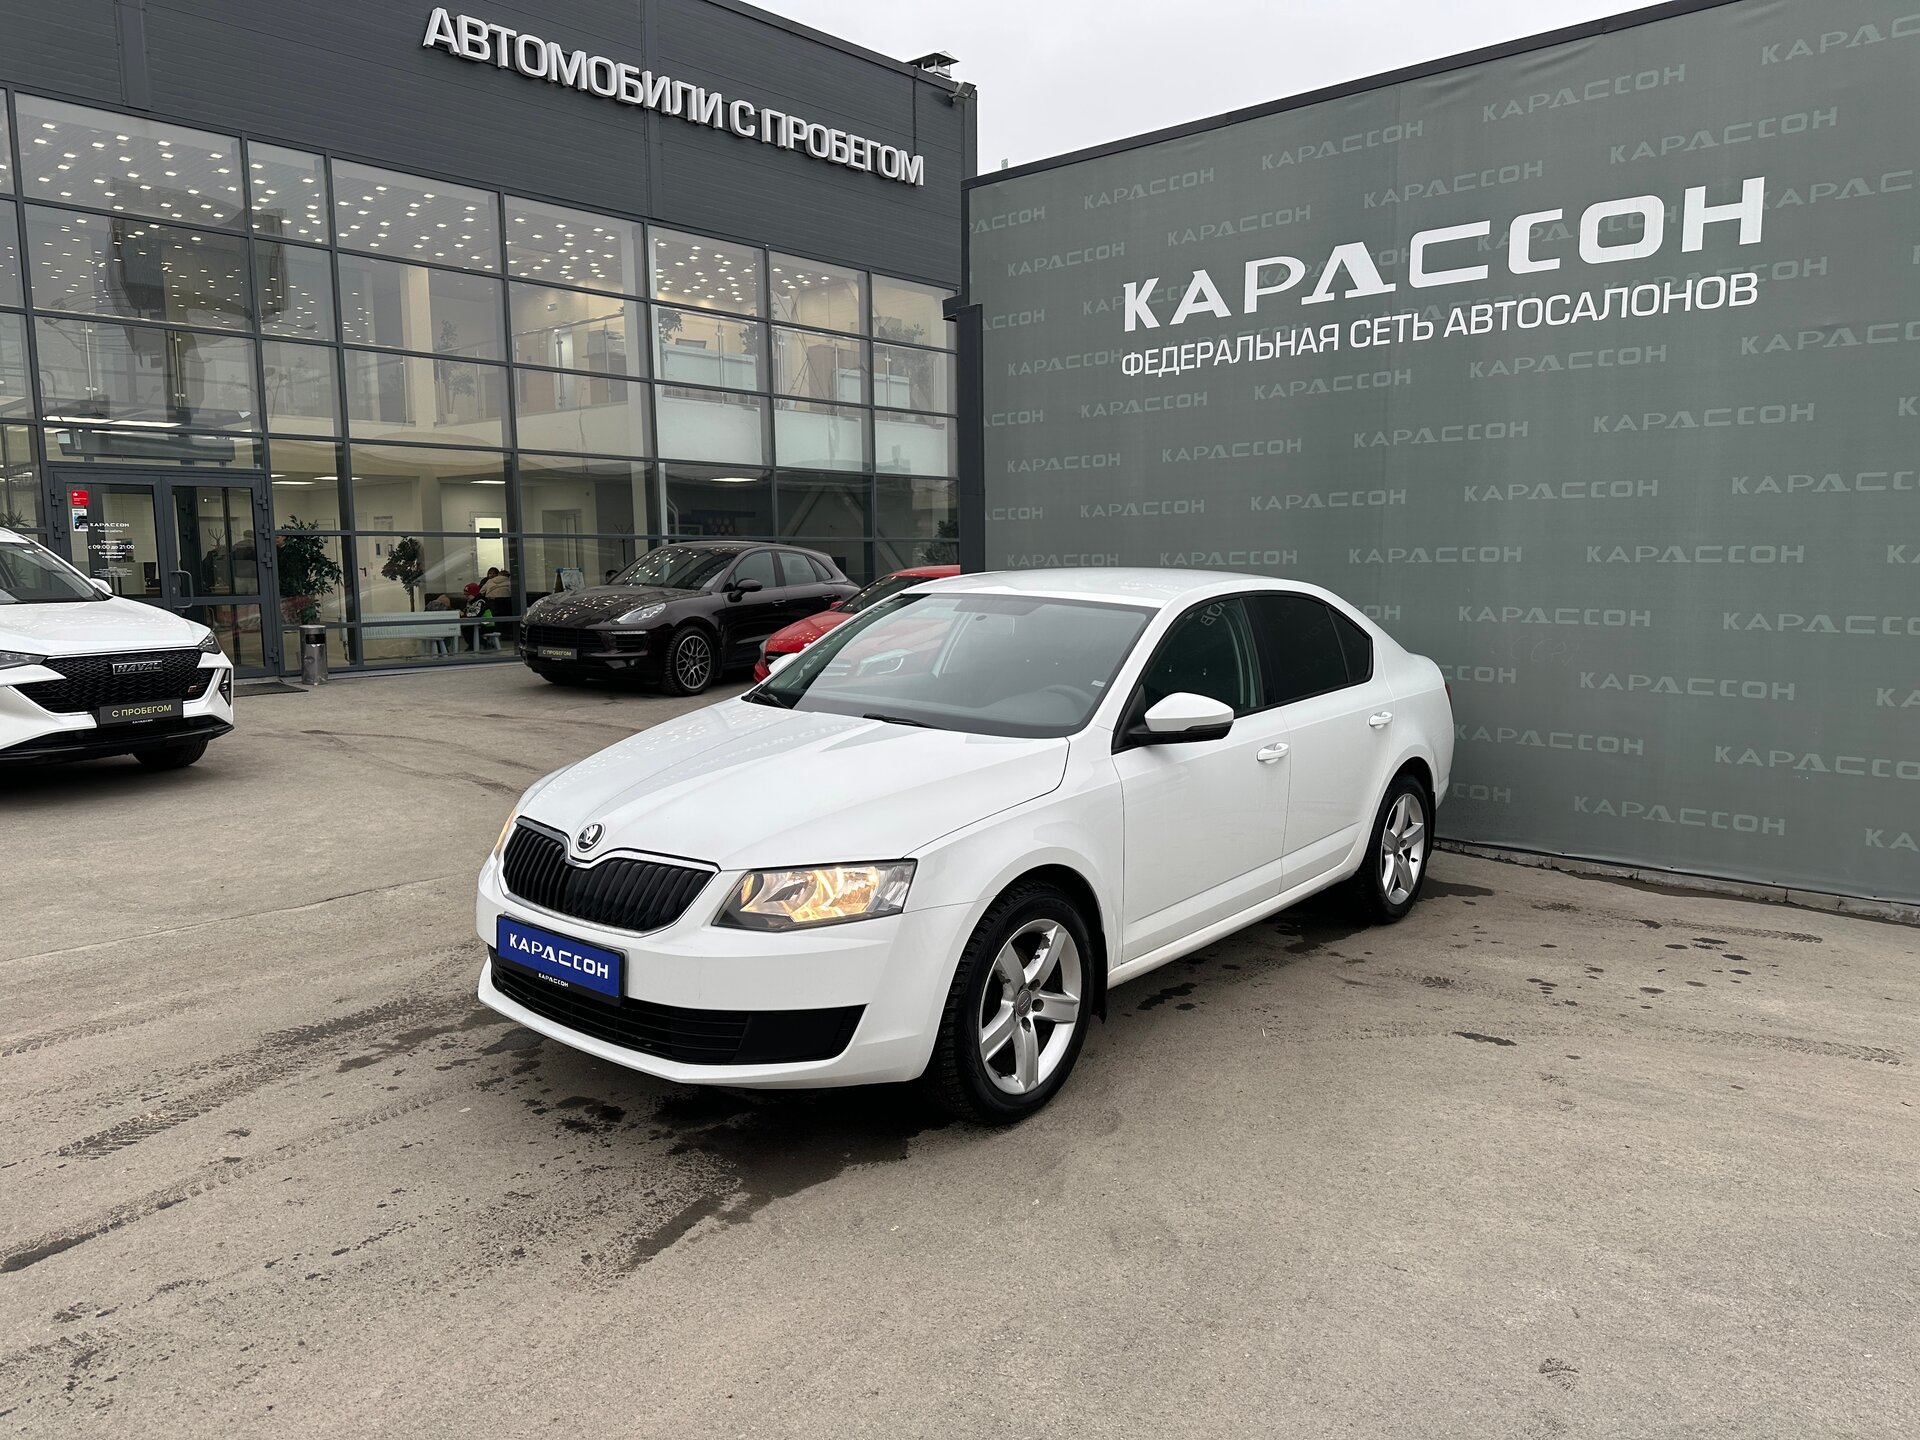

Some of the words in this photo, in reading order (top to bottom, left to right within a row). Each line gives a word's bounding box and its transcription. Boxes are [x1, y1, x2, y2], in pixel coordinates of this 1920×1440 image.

[422, 7, 724, 129] АВТОМОБИЛИ
[730, 100, 756, 138] С
[761, 108, 925, 187] ПРОБЕГОМ
[1123, 177, 1765, 332] КАРАССОН
[1122, 323, 1340, 377] ФЕДЕРАЛЬНАЯ
[1350, 312, 1434, 348] СЕТЬ
[1444, 272, 1759, 338] АВТОСАЛОНОВ
[117, 661, 161, 673] HAVAL
[112, 710, 119, 718] С
[121, 704, 172, 717] ПРОБЕГОМ
[509, 933, 609, 979] КАРАССОН
[538, 973, 569, 987] КАРАССОН
